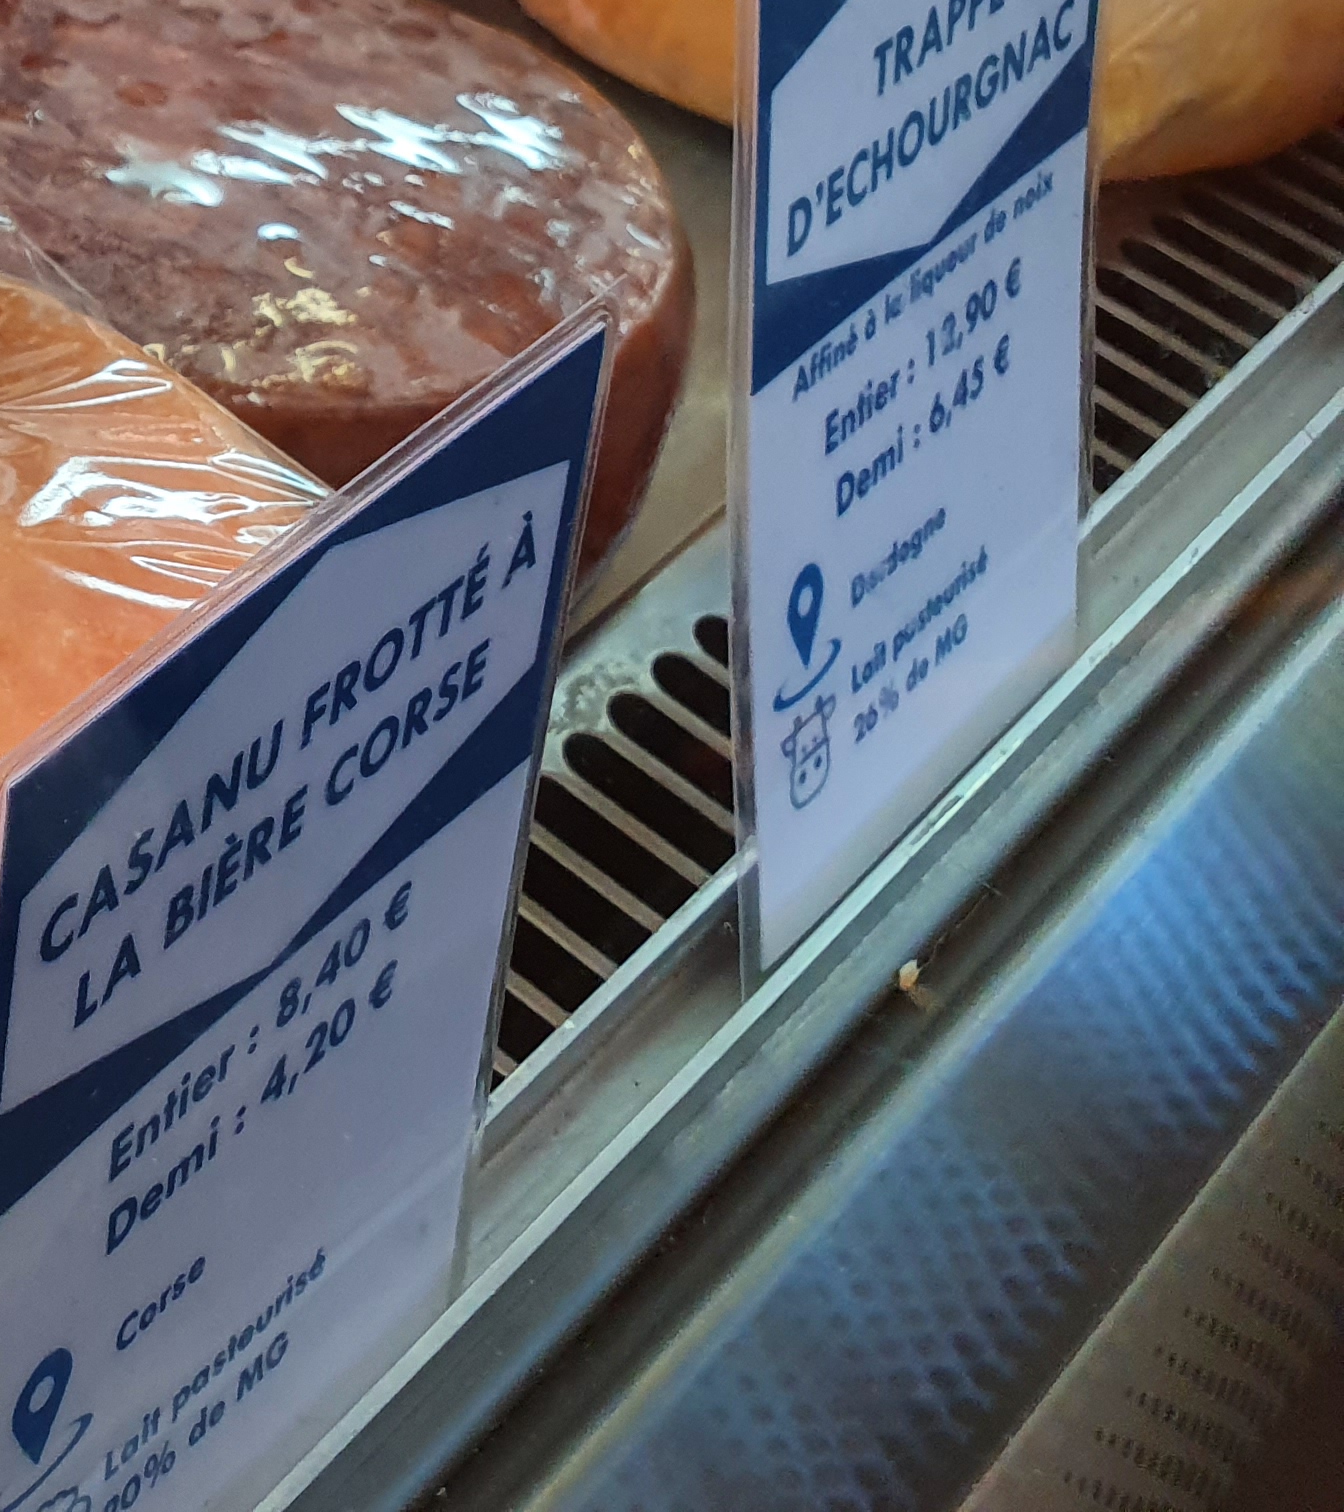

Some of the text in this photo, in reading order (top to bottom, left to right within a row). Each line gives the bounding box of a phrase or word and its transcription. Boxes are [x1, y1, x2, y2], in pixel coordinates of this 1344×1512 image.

[792, 322, 858, 402] Affiné
[865, 309, 877, 340] à
[909, 233, 978, 304] liqueur
[984, 207, 1007, 244] de
[1012, 171, 1054, 219] noix
[824, 369, 900, 456] Entier
[925, 278, 998, 368] 12,90
[1004, 255, 1021, 299] €
[835, 424, 905, 518] Demi
[927, 354, 984, 435] 6,45
[993, 333, 1010, 376] €
[851, 507, 947, 609] Dordogne
[851, 544, 988, 694] Lait pasteurisé
[905, 657, 929, 692] de
[935, 613, 968, 667] MG
[39, 509, 539, 965] CASANU FROTTÉ À
[73, 639, 492, 1029] LA BIÈRE CORSE
[105, 1116, 222, 1256] Demi
[259, 999, 356, 1105] 4,20
[368, 960, 399, 1009] €
[108, 1045, 237, 1183] Entier
[276, 919, 371, 1030] 8,40
[384, 881, 413, 931] €
[103, 1246, 328, 1481] Lait pasteurisé
[116, 1256, 207, 1351] Corse
[188, 1400, 226, 1447] de
[236, 1331, 289, 1402] MG
